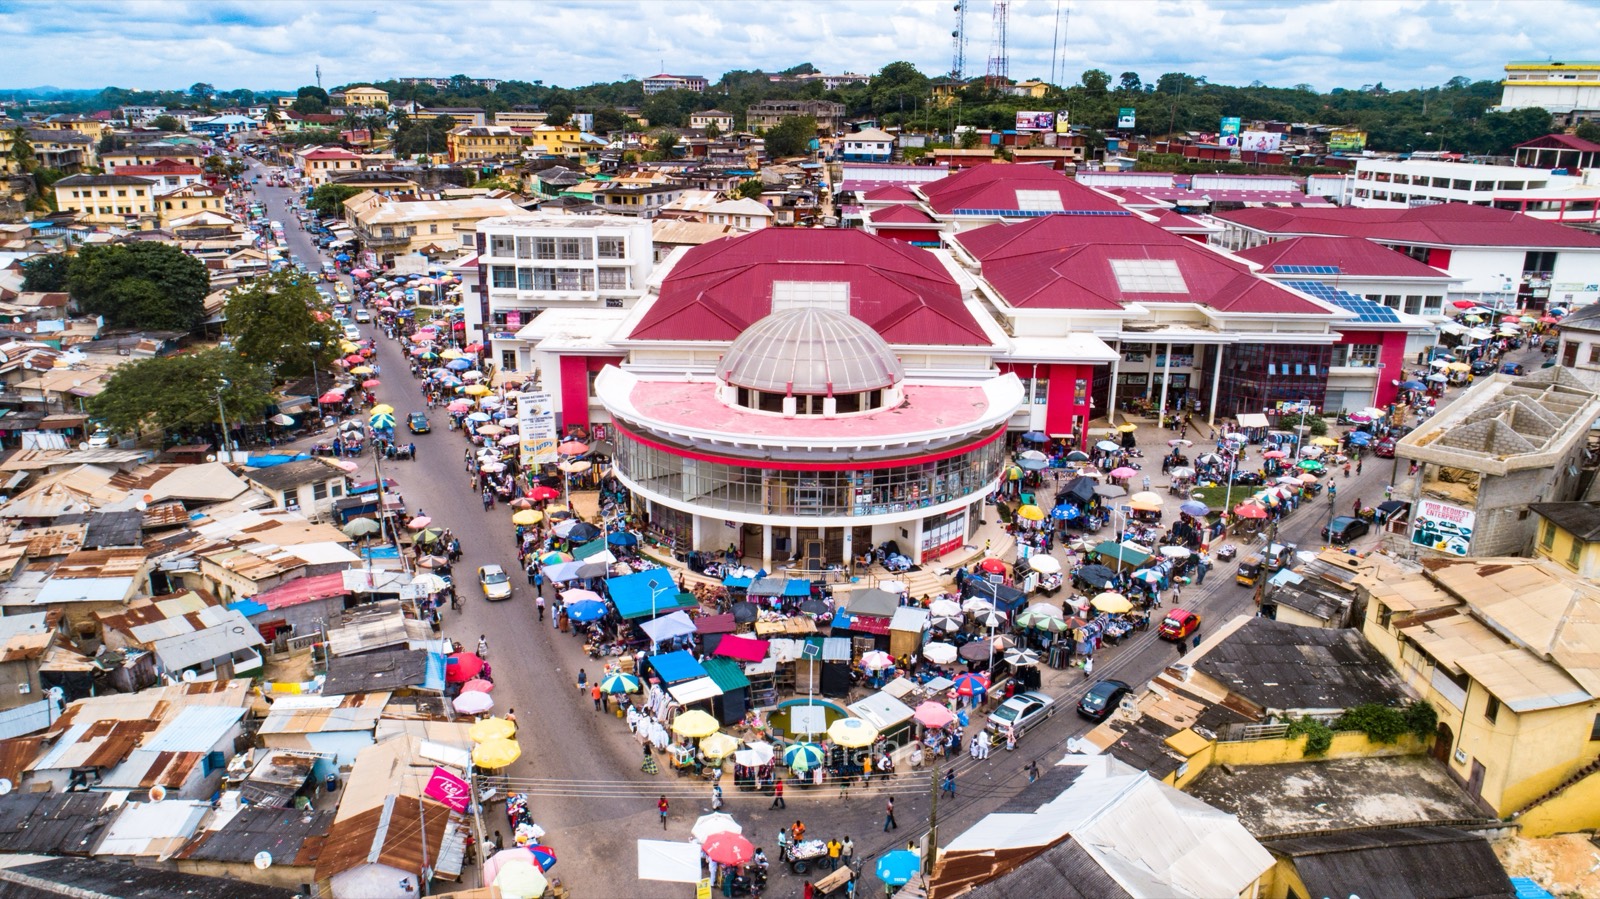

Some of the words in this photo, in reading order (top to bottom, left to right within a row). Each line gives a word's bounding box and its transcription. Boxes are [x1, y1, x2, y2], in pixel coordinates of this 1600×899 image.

[524, 440, 553, 452] Snappy
[1425, 501, 1441, 512] YOUR
[1442, 505, 1469, 518] REQUEST
[1426, 510, 1463, 523] ENTERPRISE
[440, 780, 463, 796] itel
